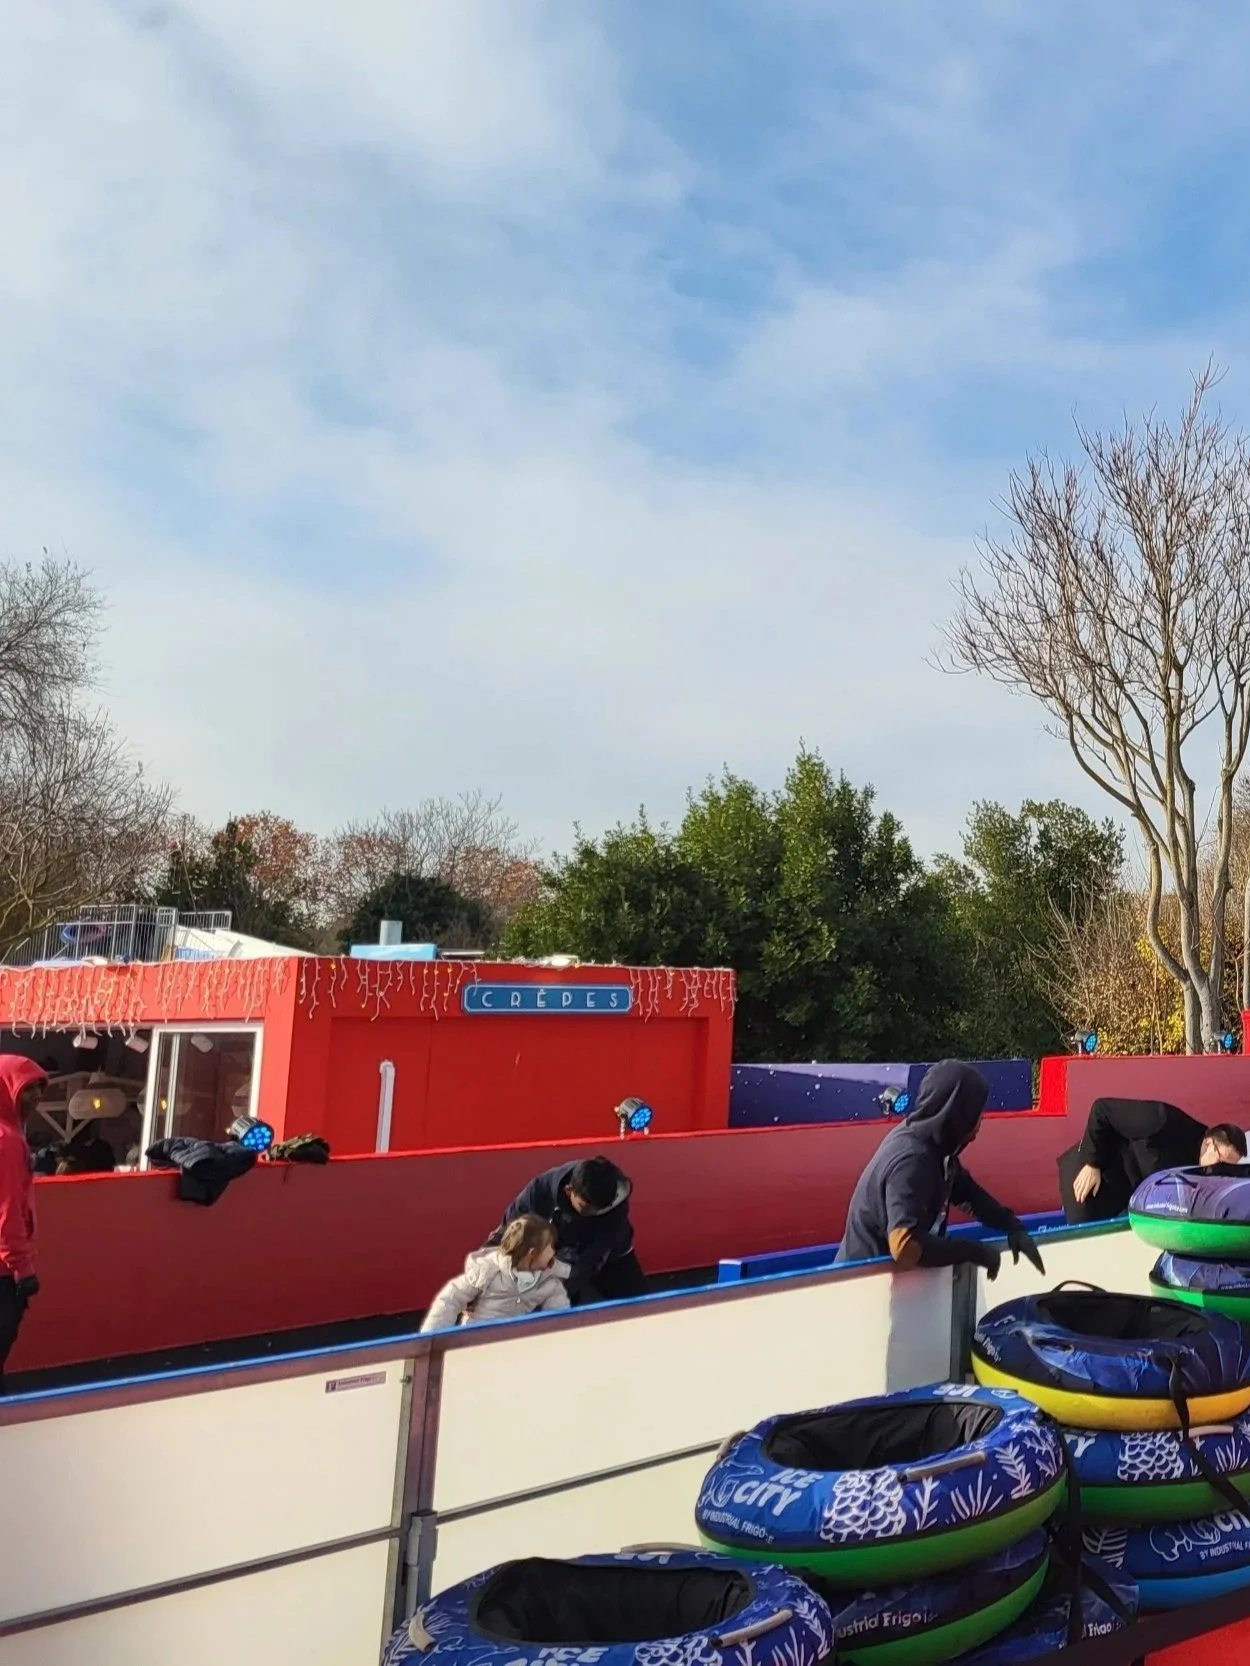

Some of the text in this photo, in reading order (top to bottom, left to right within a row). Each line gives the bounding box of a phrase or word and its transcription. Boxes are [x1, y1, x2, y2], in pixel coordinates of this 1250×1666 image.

[481, 988, 618, 1008] CRÊPES
[769, 1468, 824, 1489] ICE
[733, 1480, 802, 1517] CITY
[709, 1510, 741, 1530] INDUSTRIAL
[741, 1520, 766, 1538] FRIGO
[882, 1610, 922, 1628] Frigo
